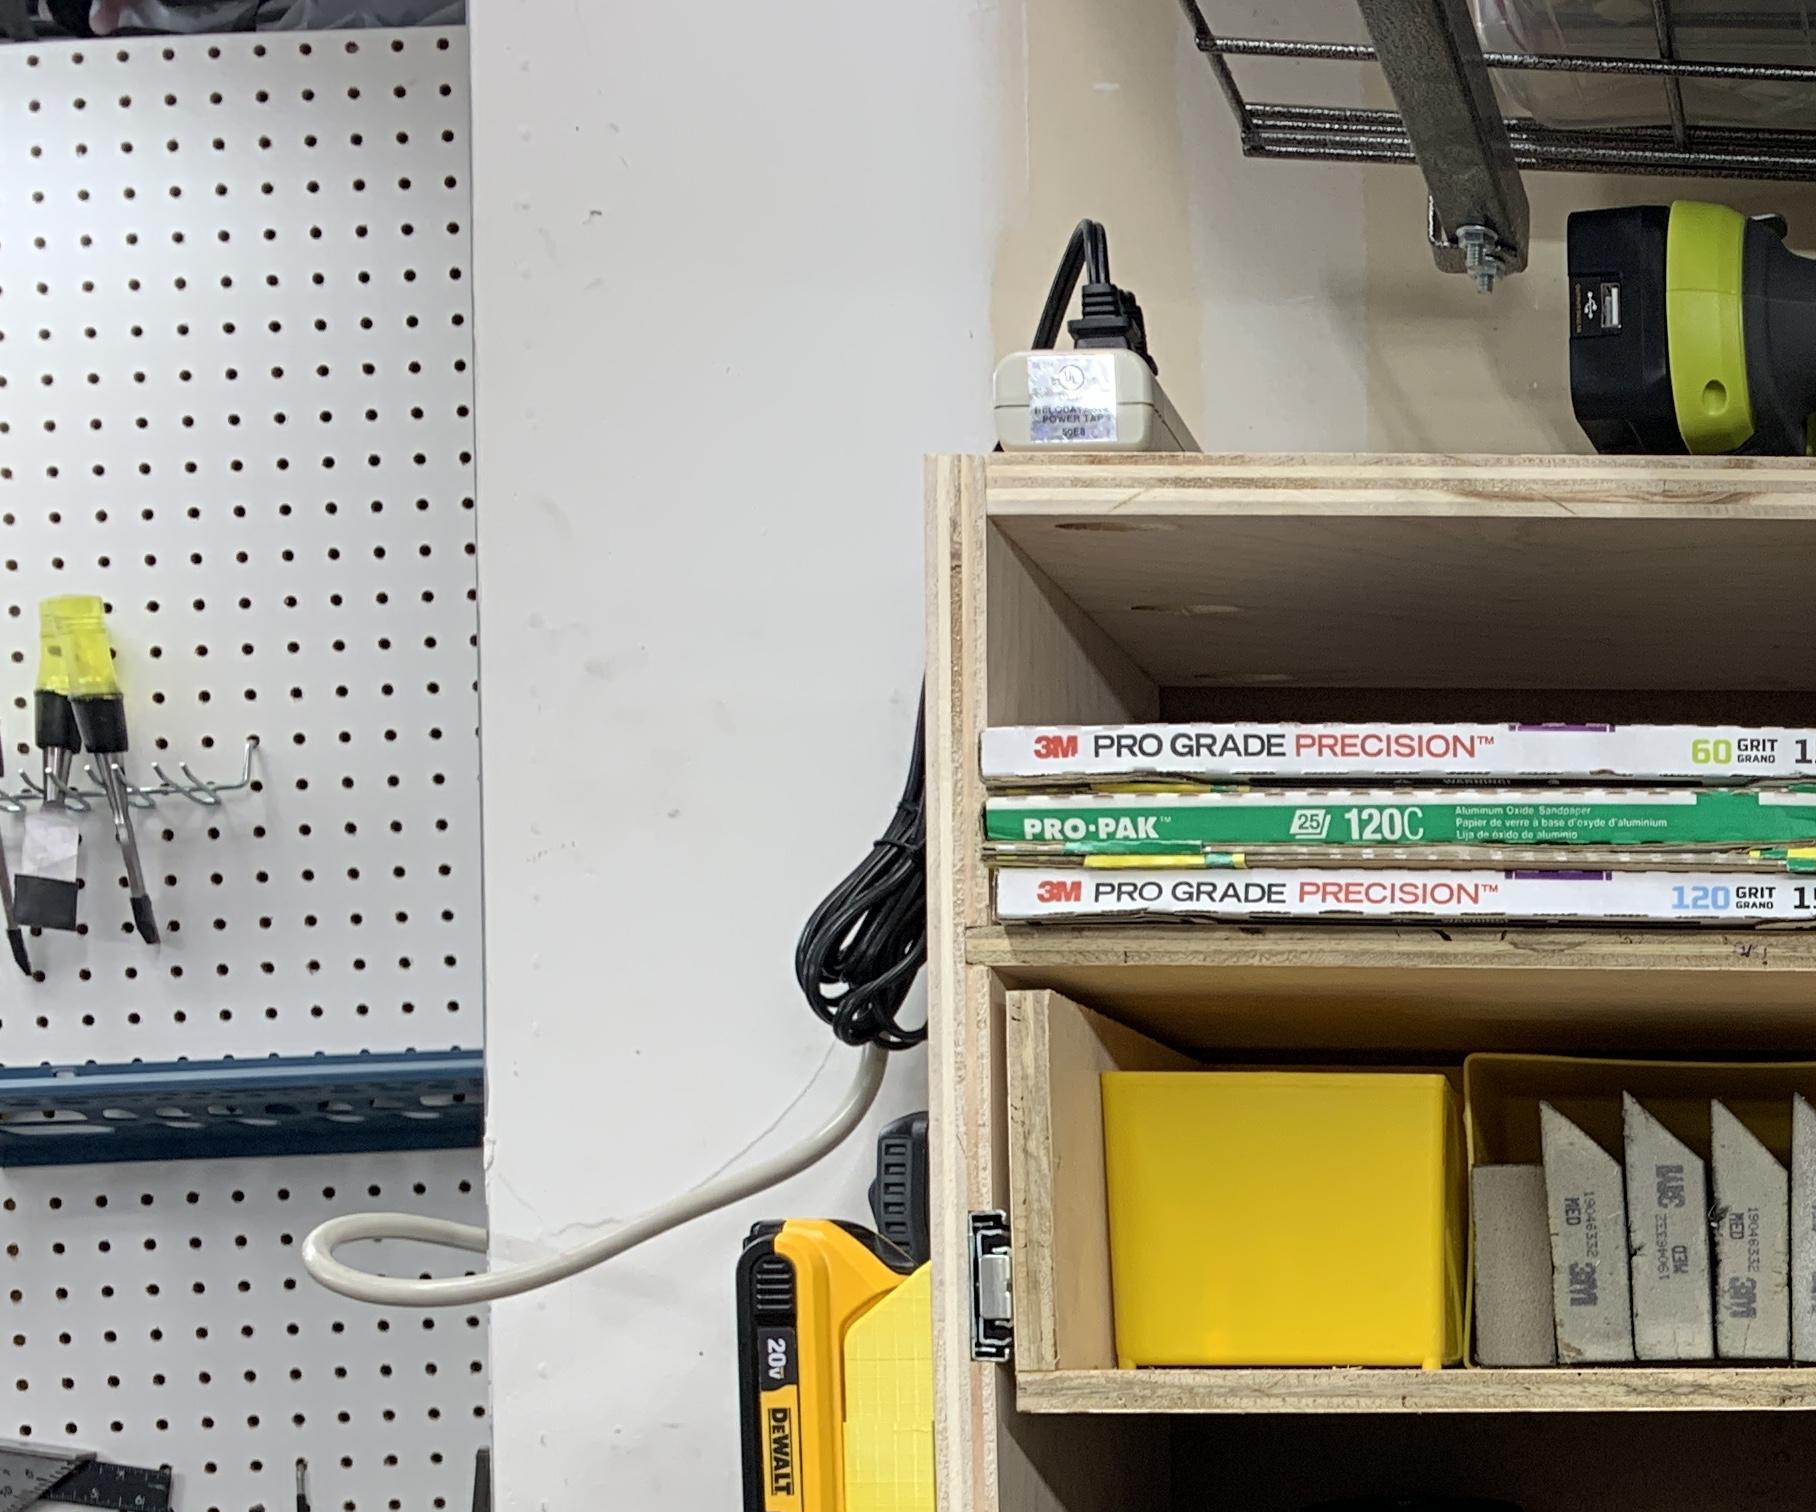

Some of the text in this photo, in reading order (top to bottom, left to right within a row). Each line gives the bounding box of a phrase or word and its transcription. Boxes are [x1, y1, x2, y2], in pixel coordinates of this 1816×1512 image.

[1042, 414, 1081, 424] POWER
[1033, 735, 1078, 760] 3M
[1094, 733, 1164, 759] PRO
[1170, 732, 1287, 759] GRADE
[1691, 737, 1779, 765] 60 GRIT
[1737, 754, 1777, 764] GRANO
[1297, 814, 1321, 831] 25
[1343, 806, 1424, 841] 120C
[1455, 806, 1591, 817] Aluminum Oxide Sandpaper
[1455, 818, 1487, 828] Papier
[1490, 818, 1503, 827] de
[1505, 819, 1530, 827] verre
[1541, 818, 1565, 828] base
[1456, 830, 1475, 841] Lija
[1477, 830, 1490, 840] de
[1521, 830, 1534, 840] de
[1036, 880, 1082, 904] 3M
[1094, 881, 1165, 904] PRO
[1170, 881, 1287, 904] GRADE
[1671, 885, 1777, 911] 120 GRIT
[1735, 901, 1775, 910] GRANO
[1655, 1164, 1685, 1209] 3M
[1564, 1197, 1582, 1226] MED
[1728, 1212, 1745, 1240] MED
[1568, 1262, 1598, 1307] 3M
[1728, 1276, 1757, 1319] 3M
[767, 1337, 788, 1380] 20V
[769, 1407, 795, 1496] DEWALT
